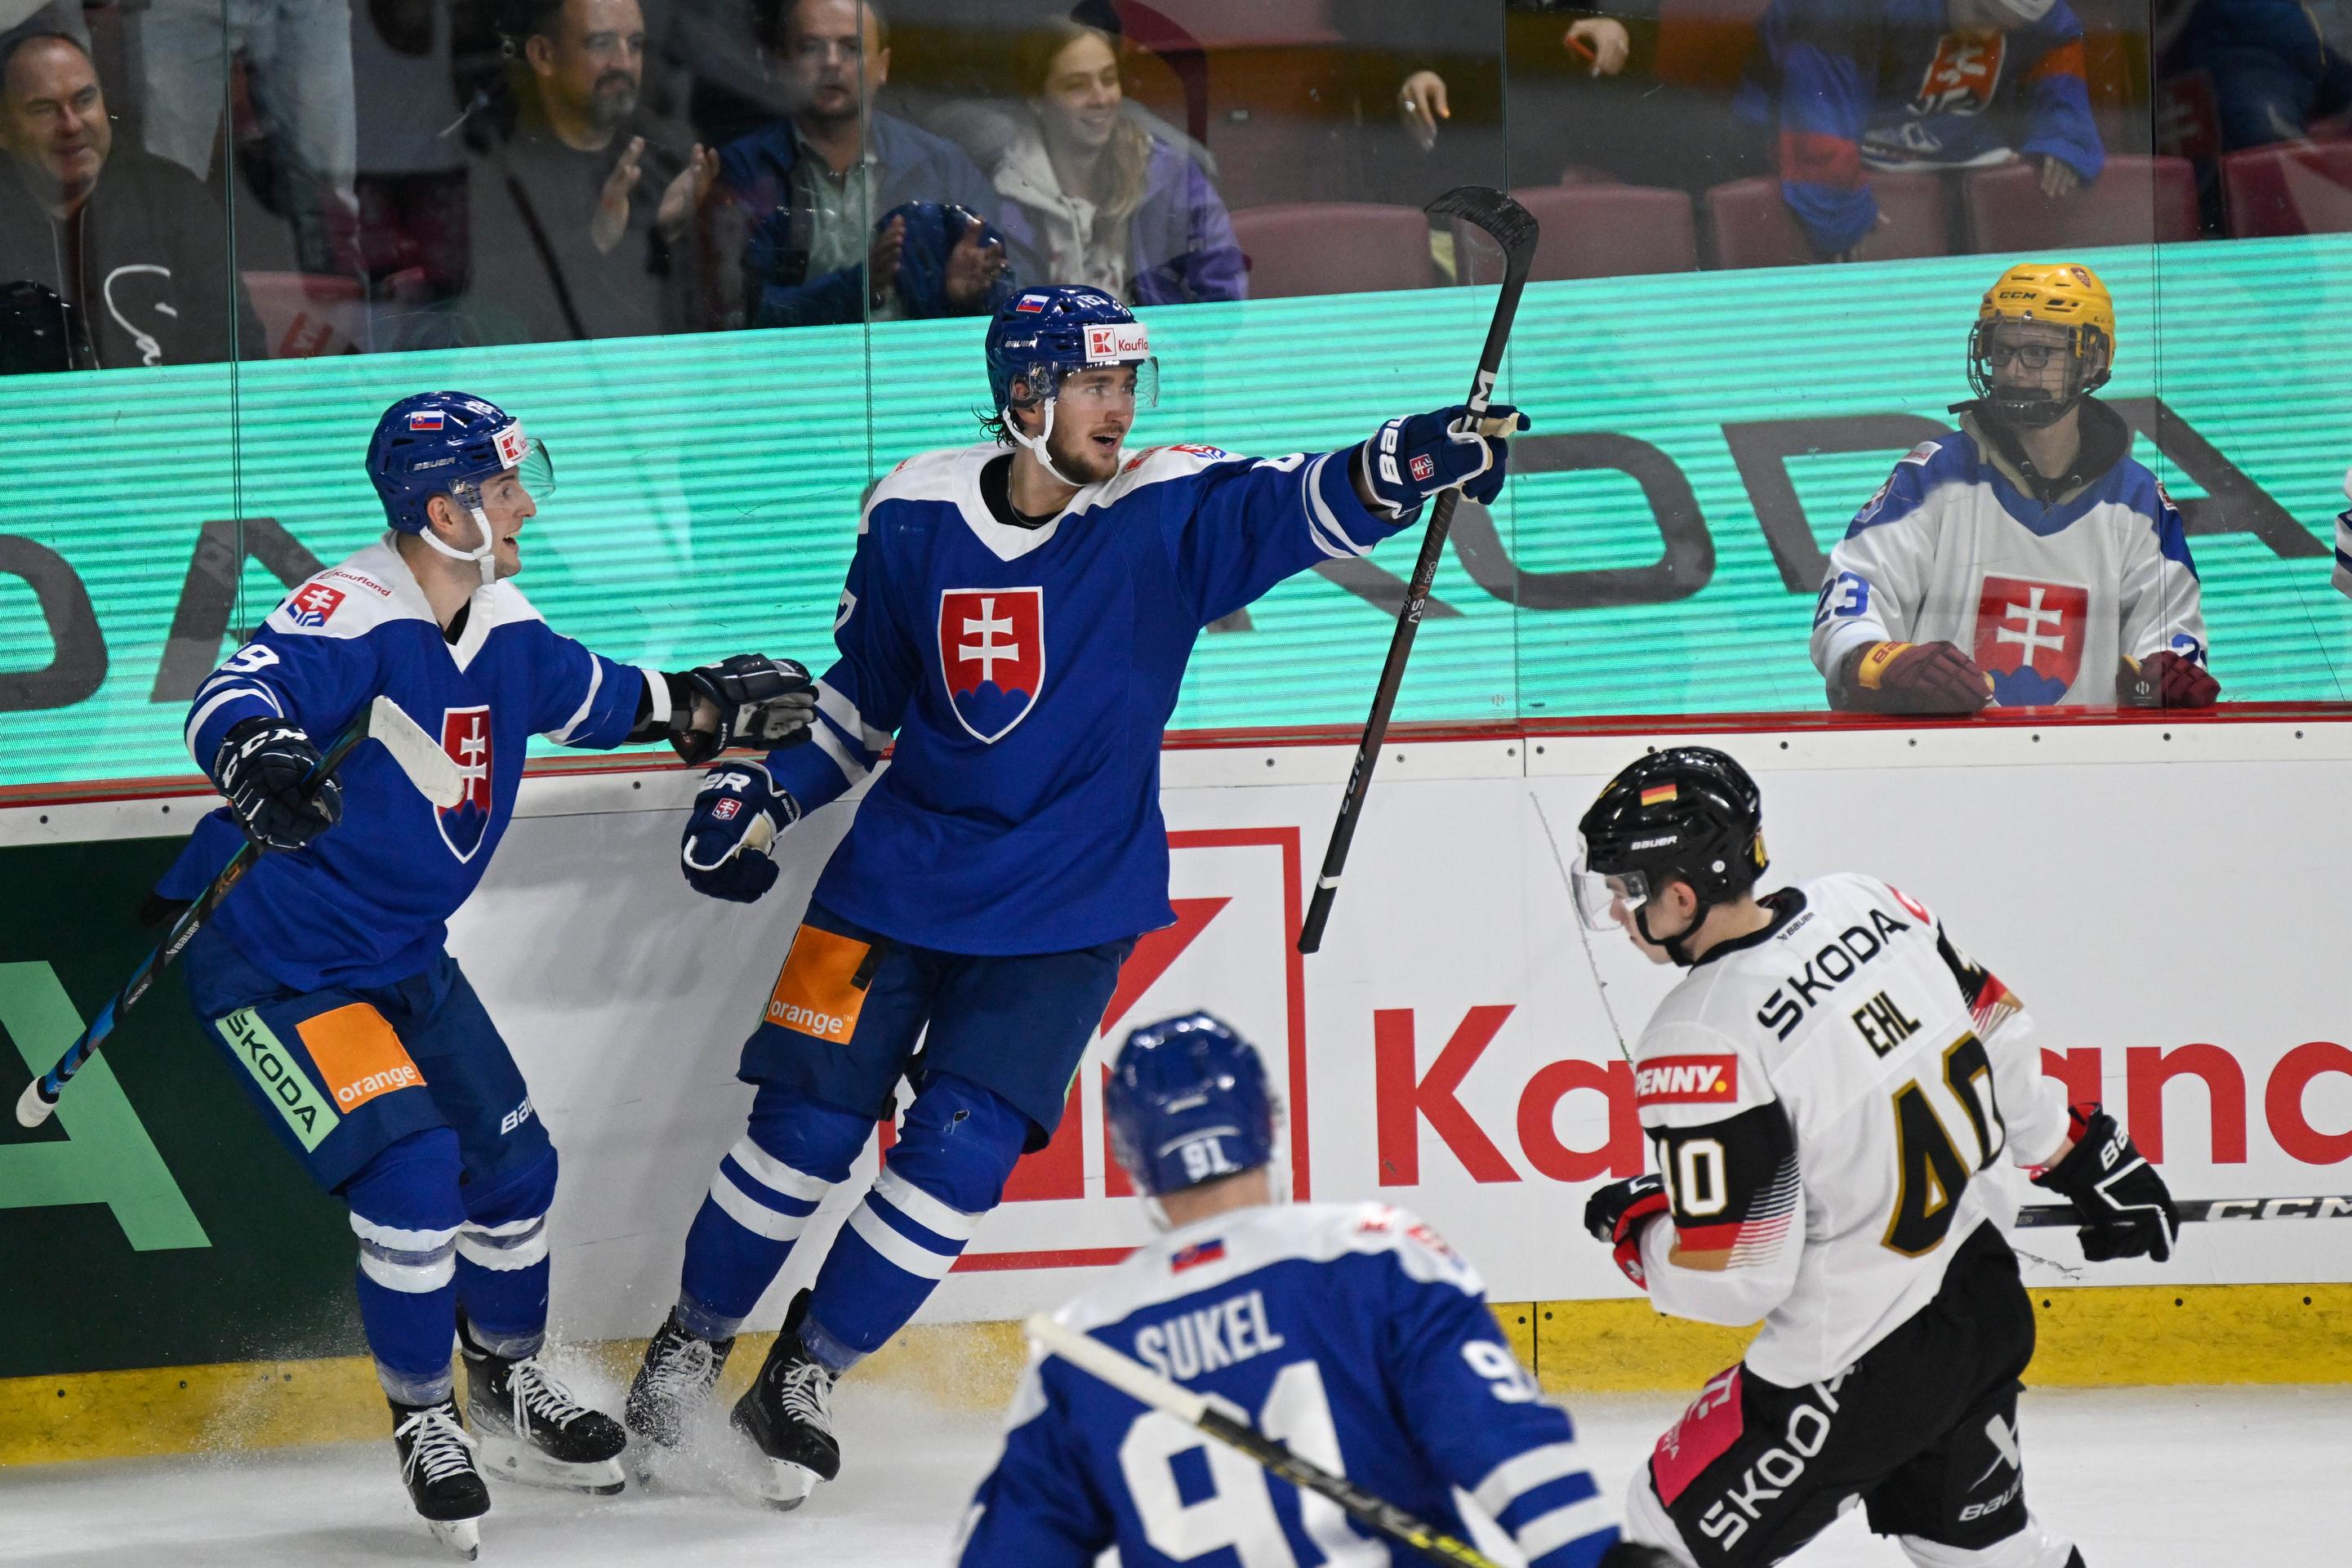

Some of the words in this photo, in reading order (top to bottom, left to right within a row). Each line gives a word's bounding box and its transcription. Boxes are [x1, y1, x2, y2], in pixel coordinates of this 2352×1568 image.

[1998, 291, 2038, 301] CCM
[1004, 338, 1038, 349] BAUER
[413, 457, 457, 471] BAUER
[332, 570, 393, 598] Kaufland
[1424, 561, 1437, 584] PRO
[1813, 571, 1870, 633] 23
[2171, 632, 2208, 668] 2
[221, 728, 309, 790] CCM
[781, 798, 795, 822] BAUER
[1631, 835, 1679, 851] BAUER
[173, 920, 201, 952] BAUER
[1785, 911, 1815, 938] BAUER
[770, 1000, 844, 1036] orange
[1850, 990, 1923, 1060] EHL
[337, 1063, 418, 1104] orange
[1181, 1136, 1242, 1183] 91
[1881, 1029, 2007, 1259] 40
[1134, 1289, 1285, 1381] SUKEL
[1958, 1468, 2025, 1522] BAU
